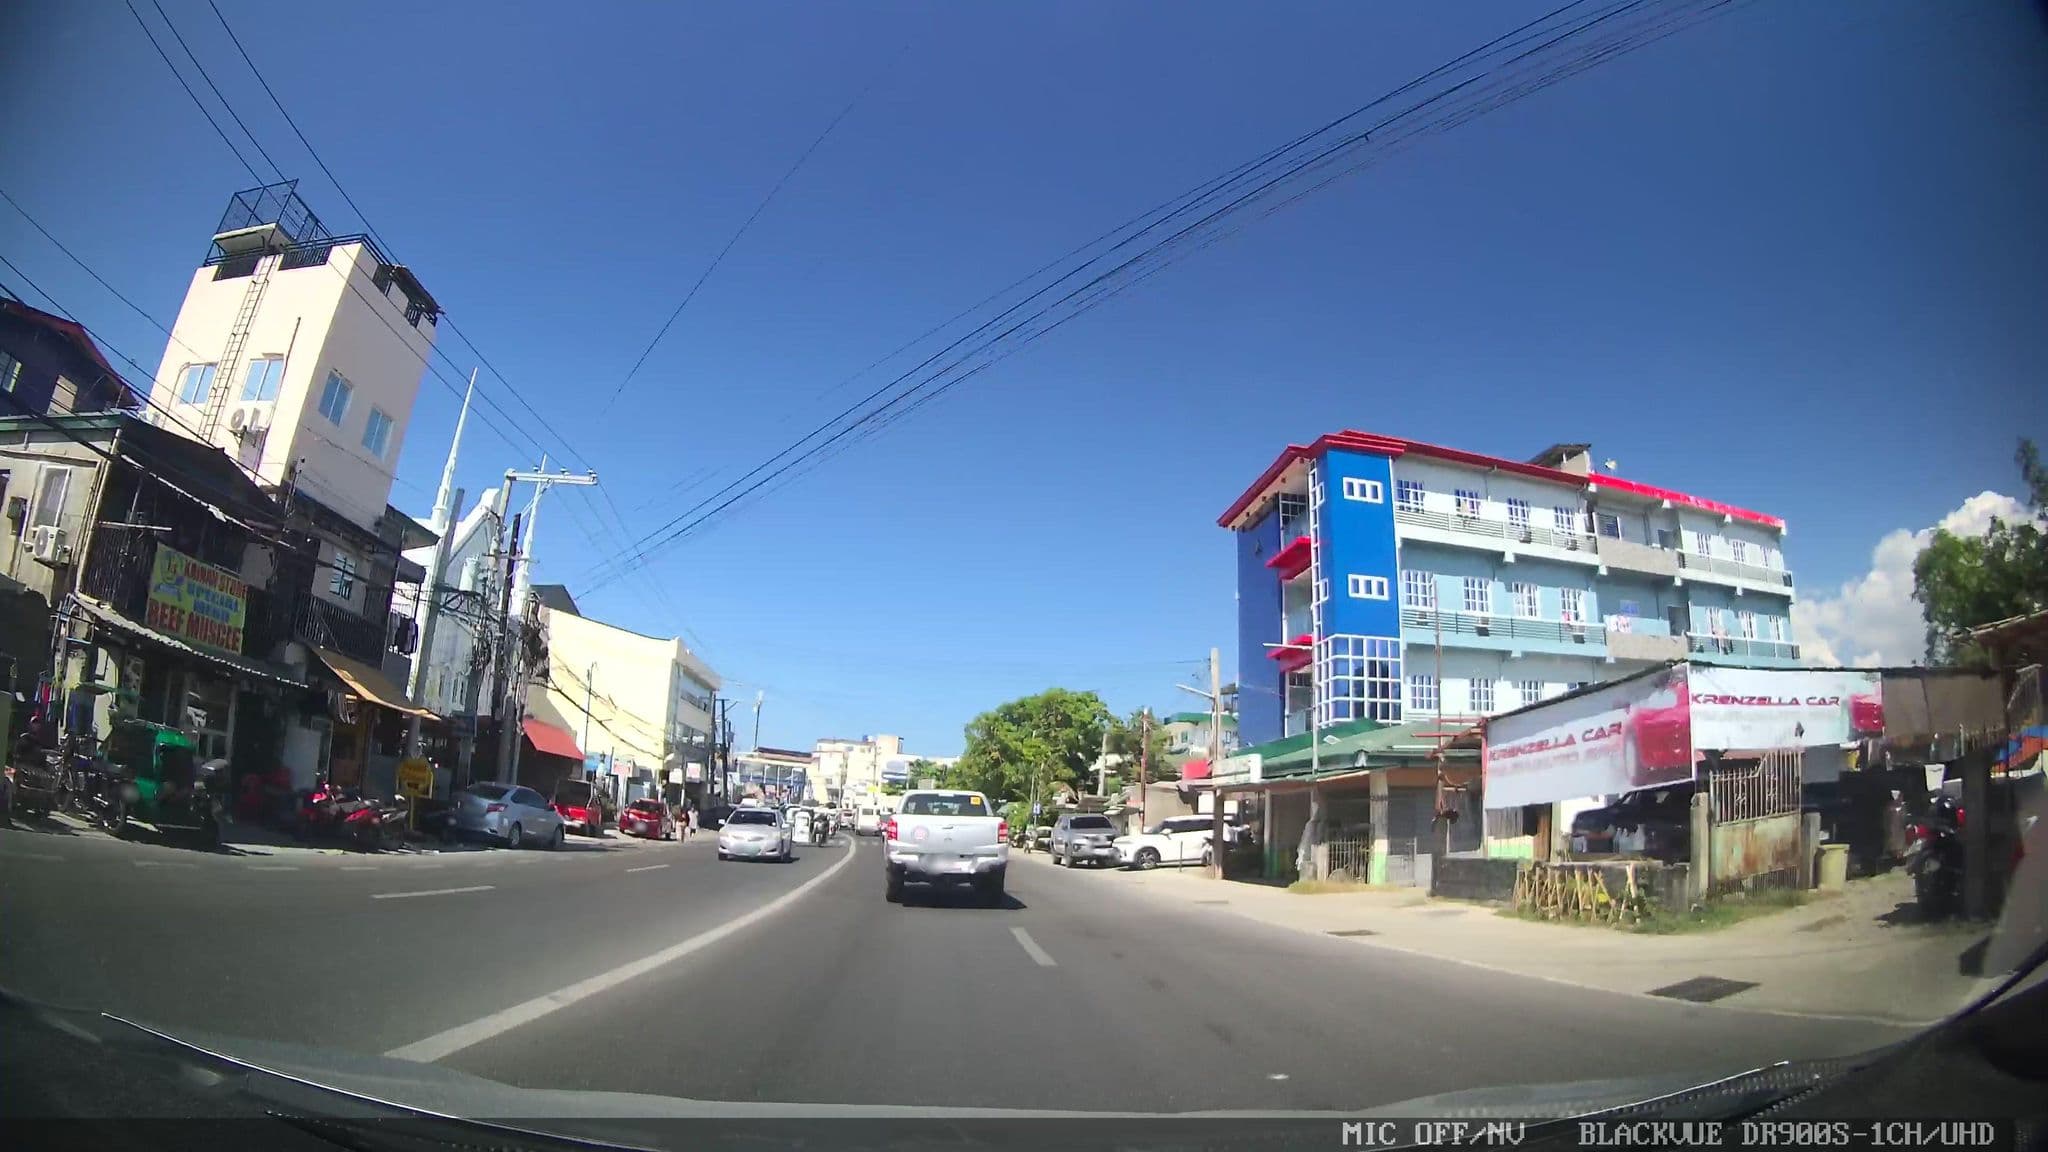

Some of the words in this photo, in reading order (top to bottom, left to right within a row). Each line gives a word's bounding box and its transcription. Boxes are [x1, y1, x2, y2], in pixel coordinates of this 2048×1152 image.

[186, 612, 242, 652] MUSCLE
[1692, 694, 1801, 706] KRENZELLA
[1805, 696, 1840, 706] CAR
[1581, 721, 1622, 743] CAR
